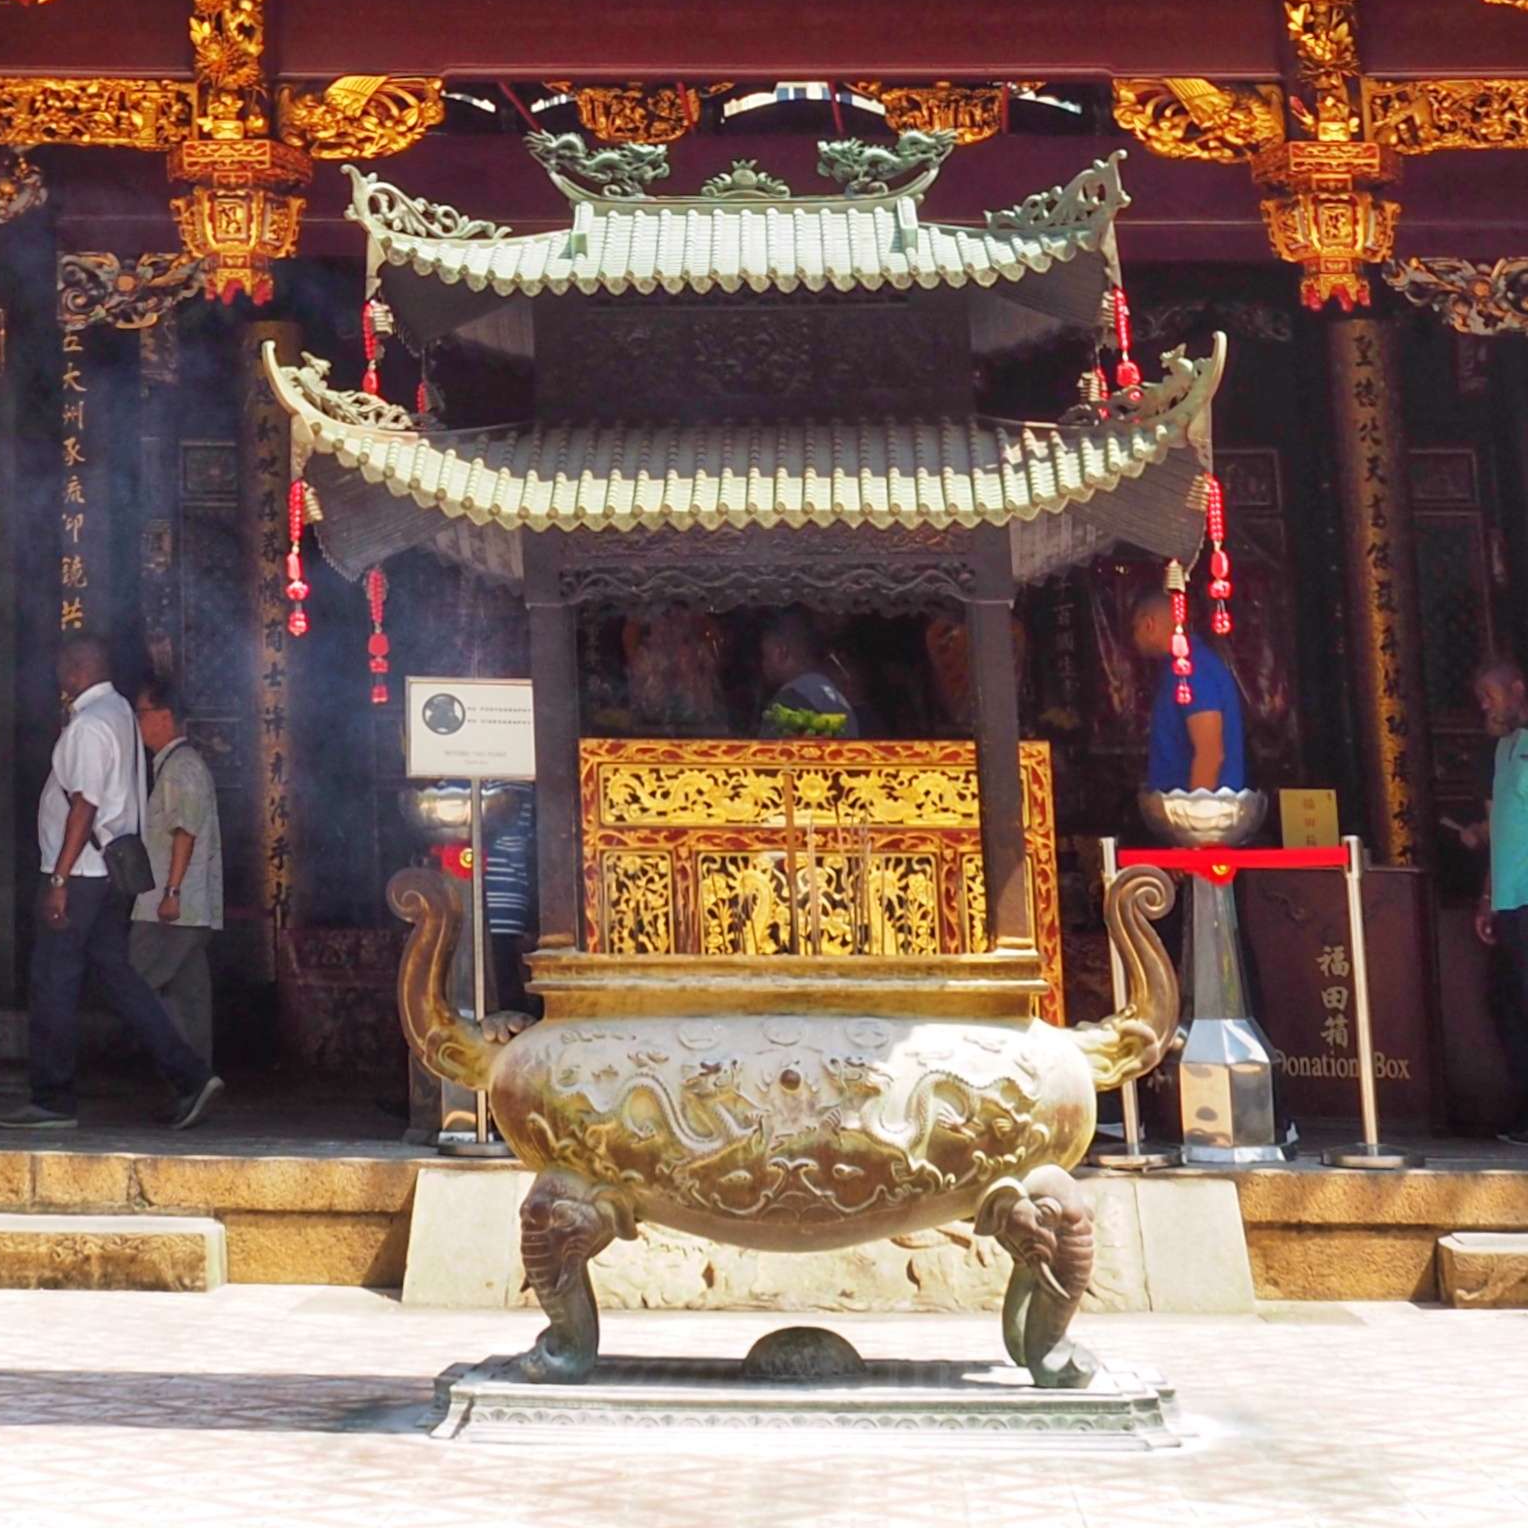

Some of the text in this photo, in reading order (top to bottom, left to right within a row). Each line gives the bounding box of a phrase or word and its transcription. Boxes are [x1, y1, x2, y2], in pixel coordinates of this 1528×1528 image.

[1315, 944, 1351, 1049] 福田箱
[1373, 1050, 1412, 1079] Box
